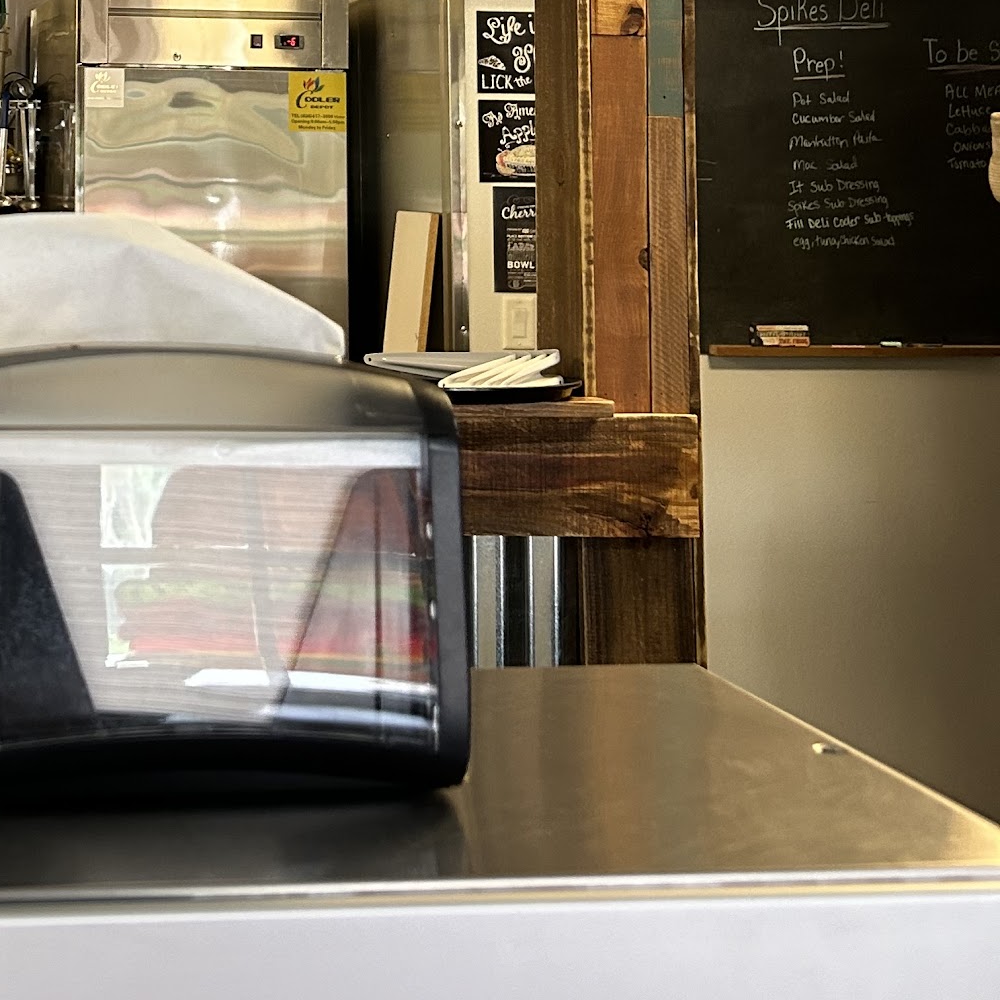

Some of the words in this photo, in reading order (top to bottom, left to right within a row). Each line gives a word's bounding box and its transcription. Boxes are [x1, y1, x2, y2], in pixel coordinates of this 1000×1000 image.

[482, 15, 526, 45] Life
[922, 38, 948, 64] To
[956, 39, 979, 63] be
[792, 47, 844, 82] Prep!
[481, 73, 514, 90] LICK
[513, 75, 533, 88] the
[792, 91, 812, 108] Pot
[819, 90, 850, 105] Salad
[504, 102, 536, 120] Ame
[810, 180, 834, 194] Sub
[836, 178, 880, 193] Dressing
[824, 198, 845, 210] Sub
[848, 195, 889, 209] Dressing
